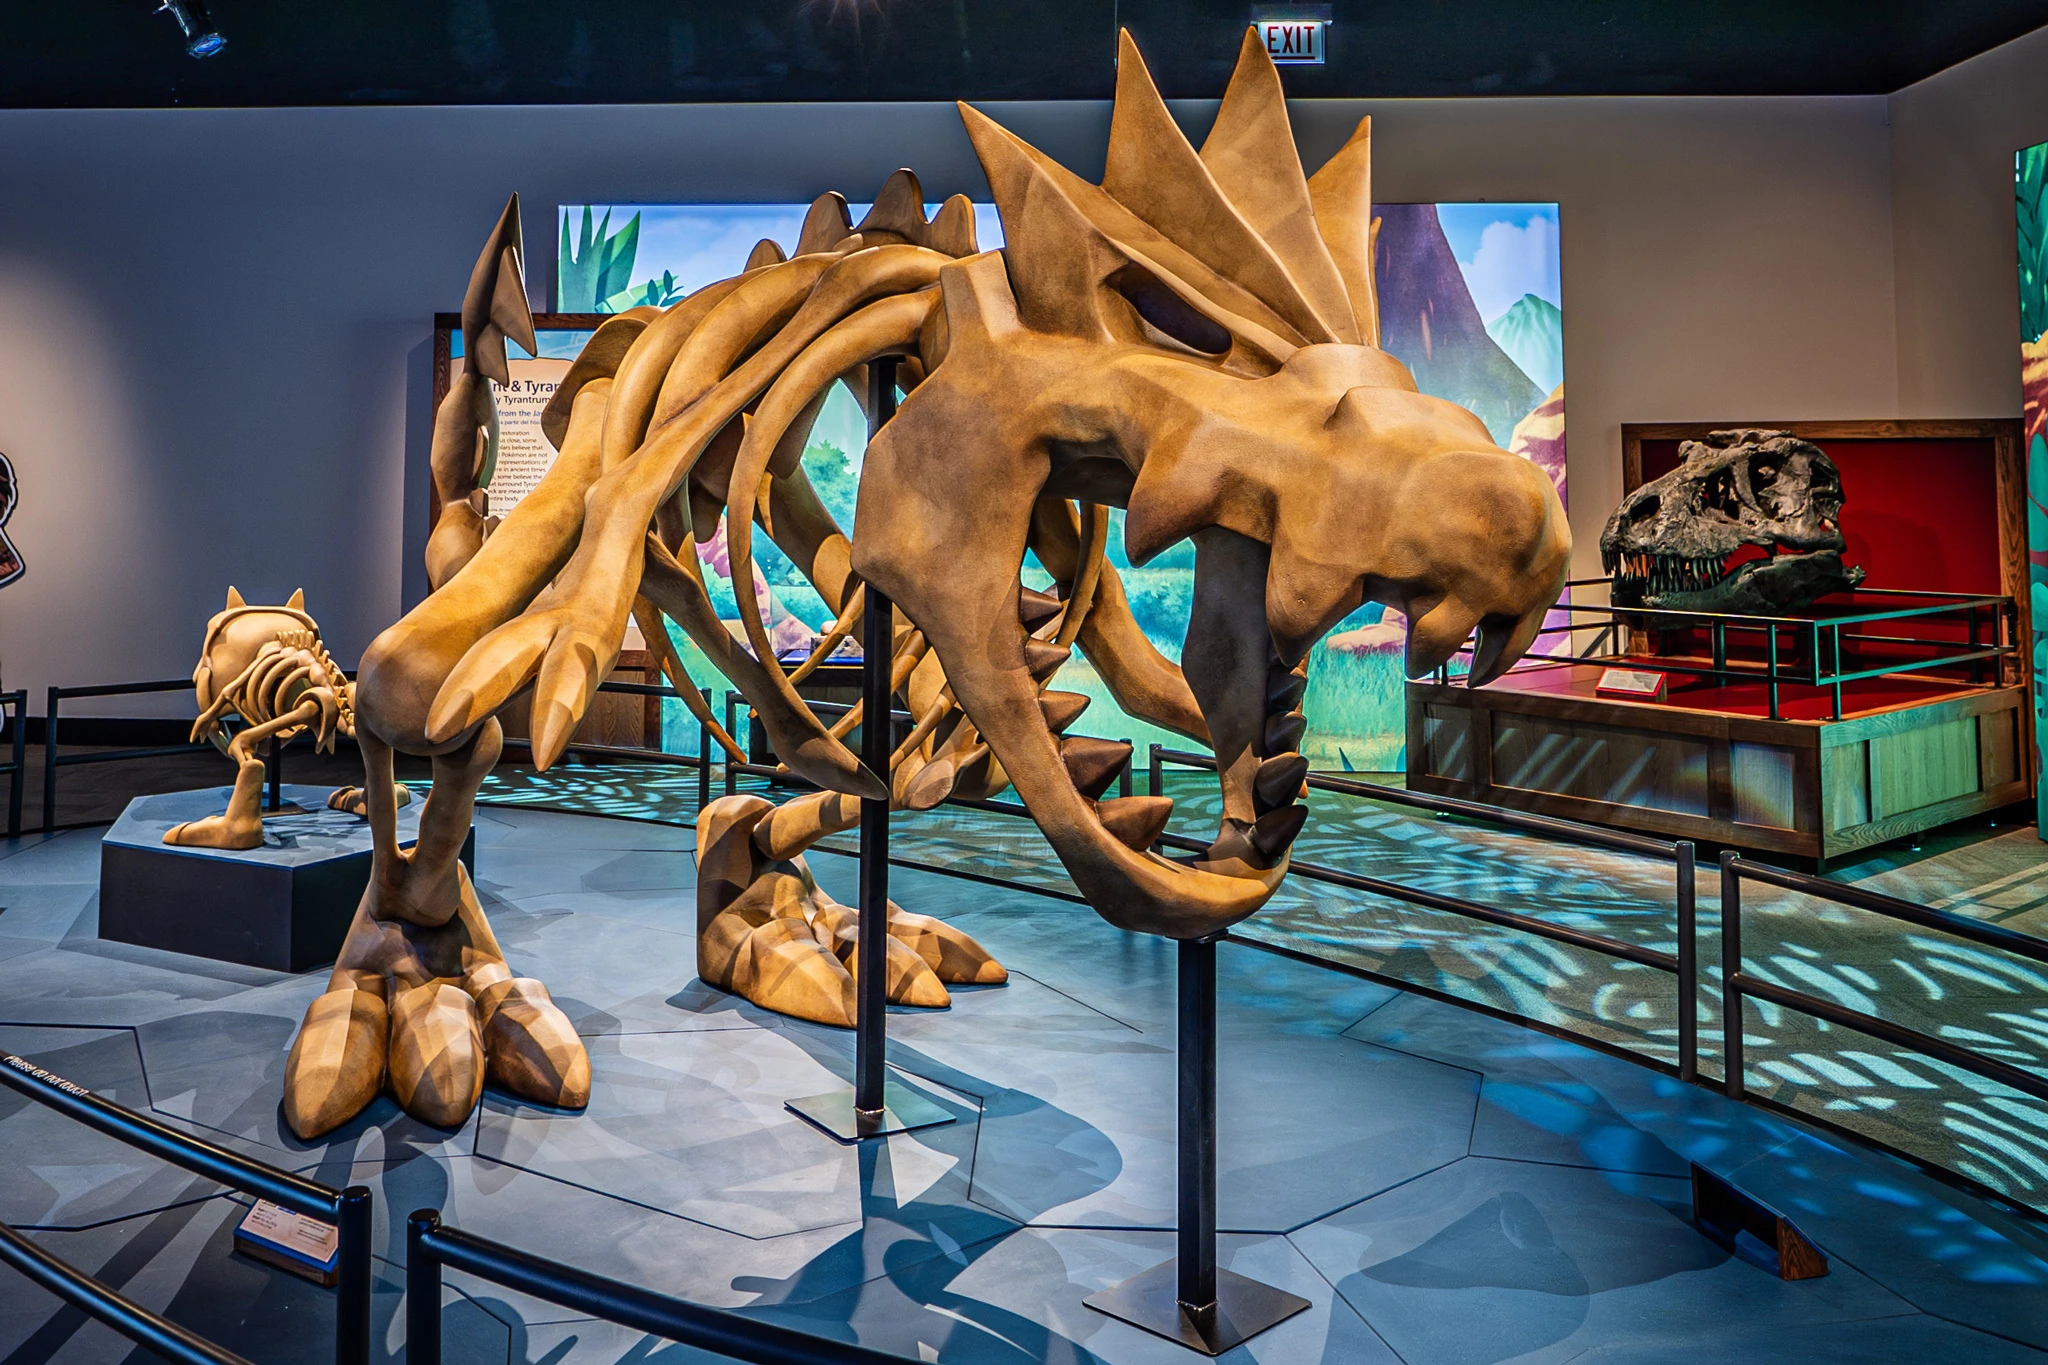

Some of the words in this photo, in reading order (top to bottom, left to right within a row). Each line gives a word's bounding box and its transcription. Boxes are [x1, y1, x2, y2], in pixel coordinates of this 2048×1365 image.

[1268, 26, 1314, 54] EXIT
[511, 380, 522, 392] &
[3, 1056, 37, 1072] Please
[32, 1068, 49, 1078] do
[44, 1074, 66, 1086] not
[58, 1081, 89, 1097] touch
